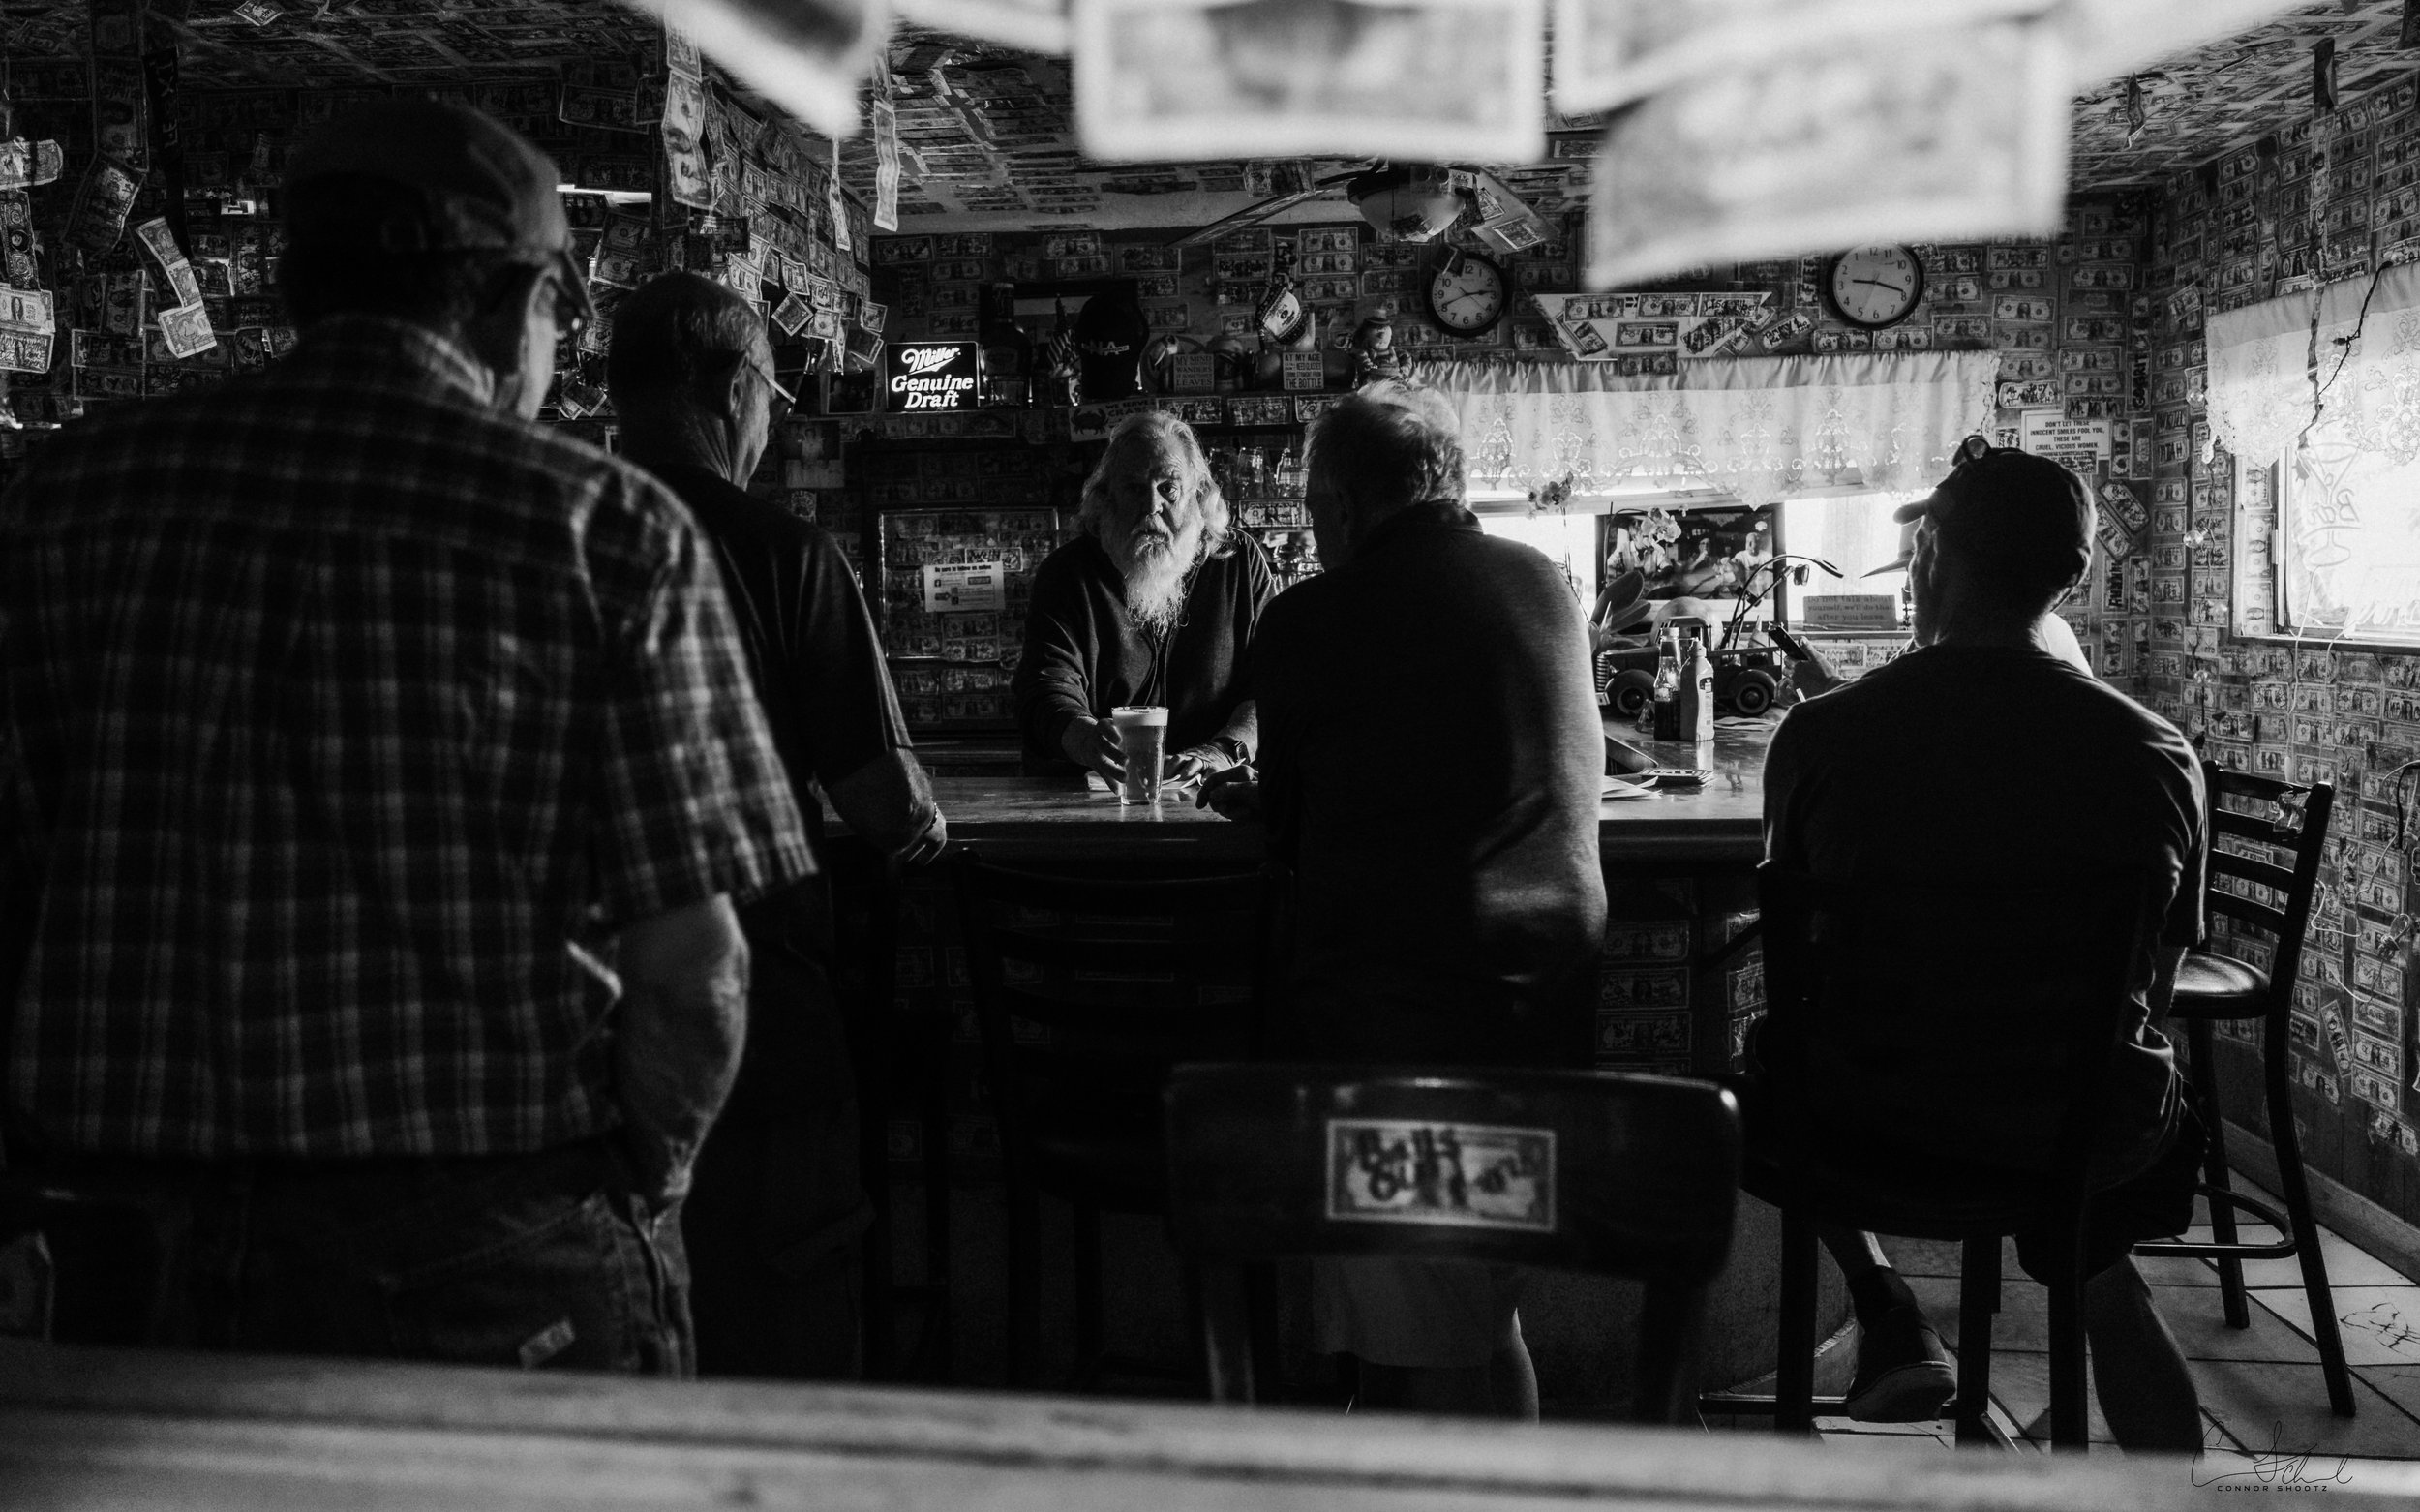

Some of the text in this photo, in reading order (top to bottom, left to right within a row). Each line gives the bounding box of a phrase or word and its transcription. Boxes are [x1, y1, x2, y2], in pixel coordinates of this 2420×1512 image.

[1870, 247, 1878, 257] 12
[1885, 249, 1892, 258] 11
[1855, 253, 1859, 261] 1
[1465, 265, 1473, 274] 12
[1897, 260, 1906, 270] 10
[1478, 268, 1483, 277] 1
[1842, 265, 1848, 275] 2
[1442, 278, 1452, 287] 10
[1486, 278, 1494, 287] 2
[1905, 276, 1912, 285] 9
[1838, 281, 1844, 290] 3
[1437, 290, 1444, 299] 9
[1491, 291, 1497, 300] 3
[1900, 291, 1907, 301] 8
[1843, 296, 1850, 305] 4
[1441, 304, 1448, 313] 8
[1857, 307, 1863, 317] 5
[1891, 304, 1896, 314] 7
[1476, 313, 1483, 321] 5
[1873, 310, 1880, 319] 6
[901, 347, 961, 373] Miller
[1176, 356, 1211, 365] MY MIND
[891, 374, 974, 394] Genuine
[1286, 378, 1321, 388] THE BOTTLE
[904, 391, 959, 408] Draft
